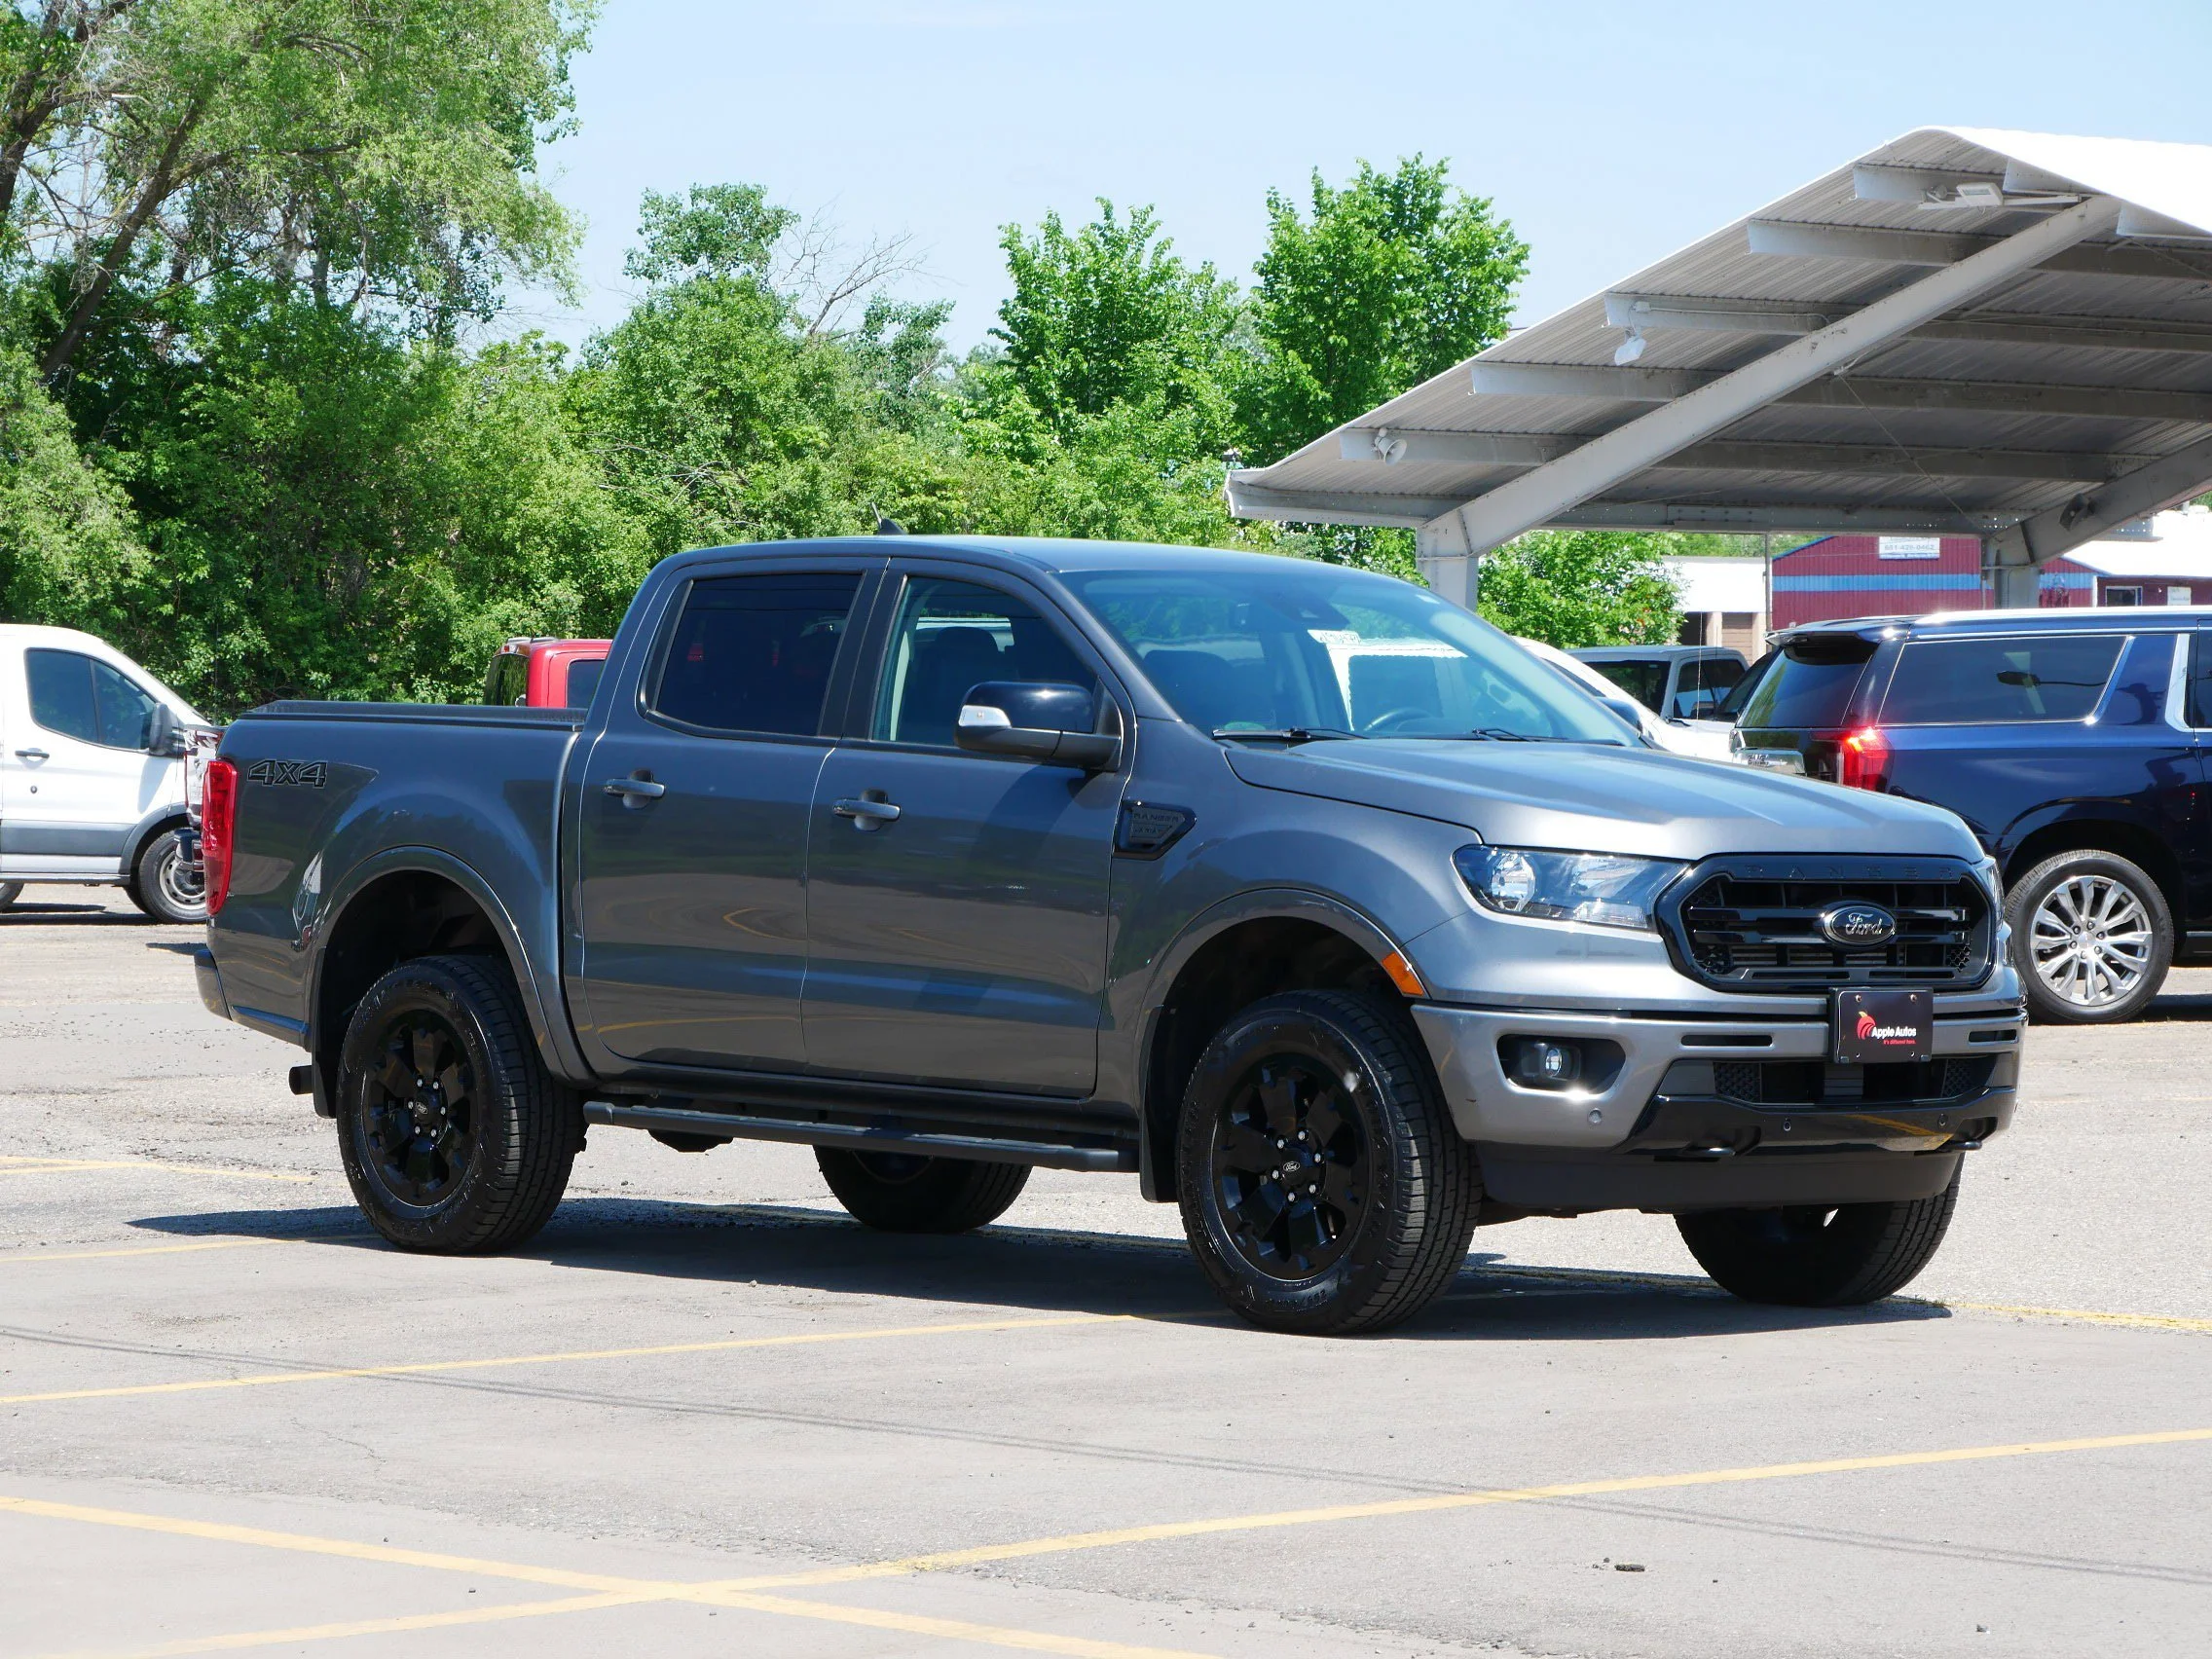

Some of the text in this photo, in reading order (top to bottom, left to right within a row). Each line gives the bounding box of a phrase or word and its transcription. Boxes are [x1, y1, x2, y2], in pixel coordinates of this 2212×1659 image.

[1845, 912, 1883, 936] Ford
[1871, 1026, 1917, 1039] Apple Autos
